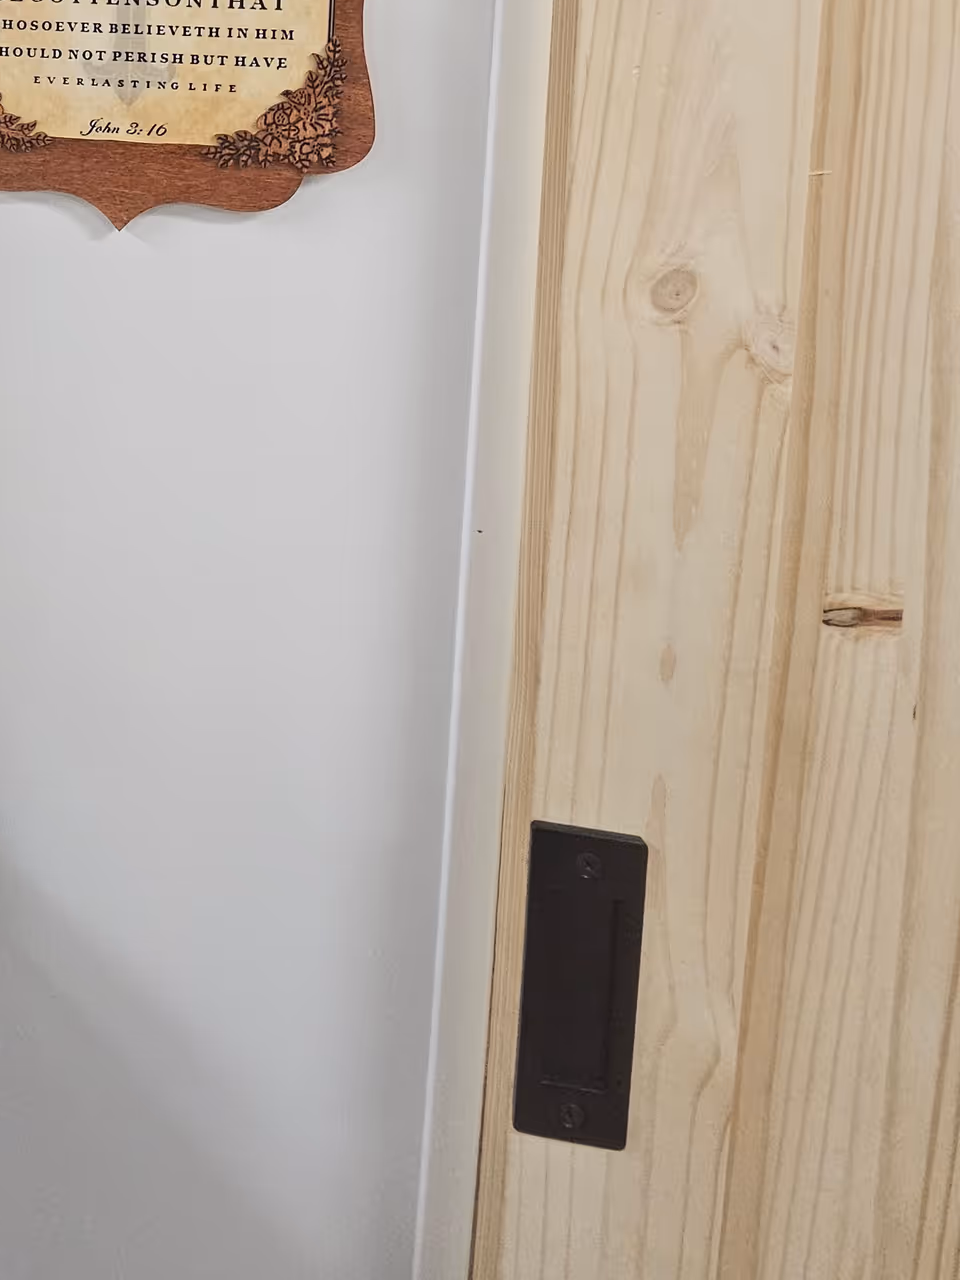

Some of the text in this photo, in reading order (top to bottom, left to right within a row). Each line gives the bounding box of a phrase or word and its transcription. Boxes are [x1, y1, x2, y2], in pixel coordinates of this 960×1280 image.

[108, 23, 221, 38] BELIEVETH
[226, 27, 249, 39] IN
[254, 28, 295, 41] HIM
[68, 48, 106, 61] NOT
[112, 50, 184, 65] PERISH
[189, 54, 229, 66] BUT
[234, 55, 288, 70] HAVE
[33, 75, 238, 93] EVERLASTING LIFE
[80, 117, 120, 137] John
